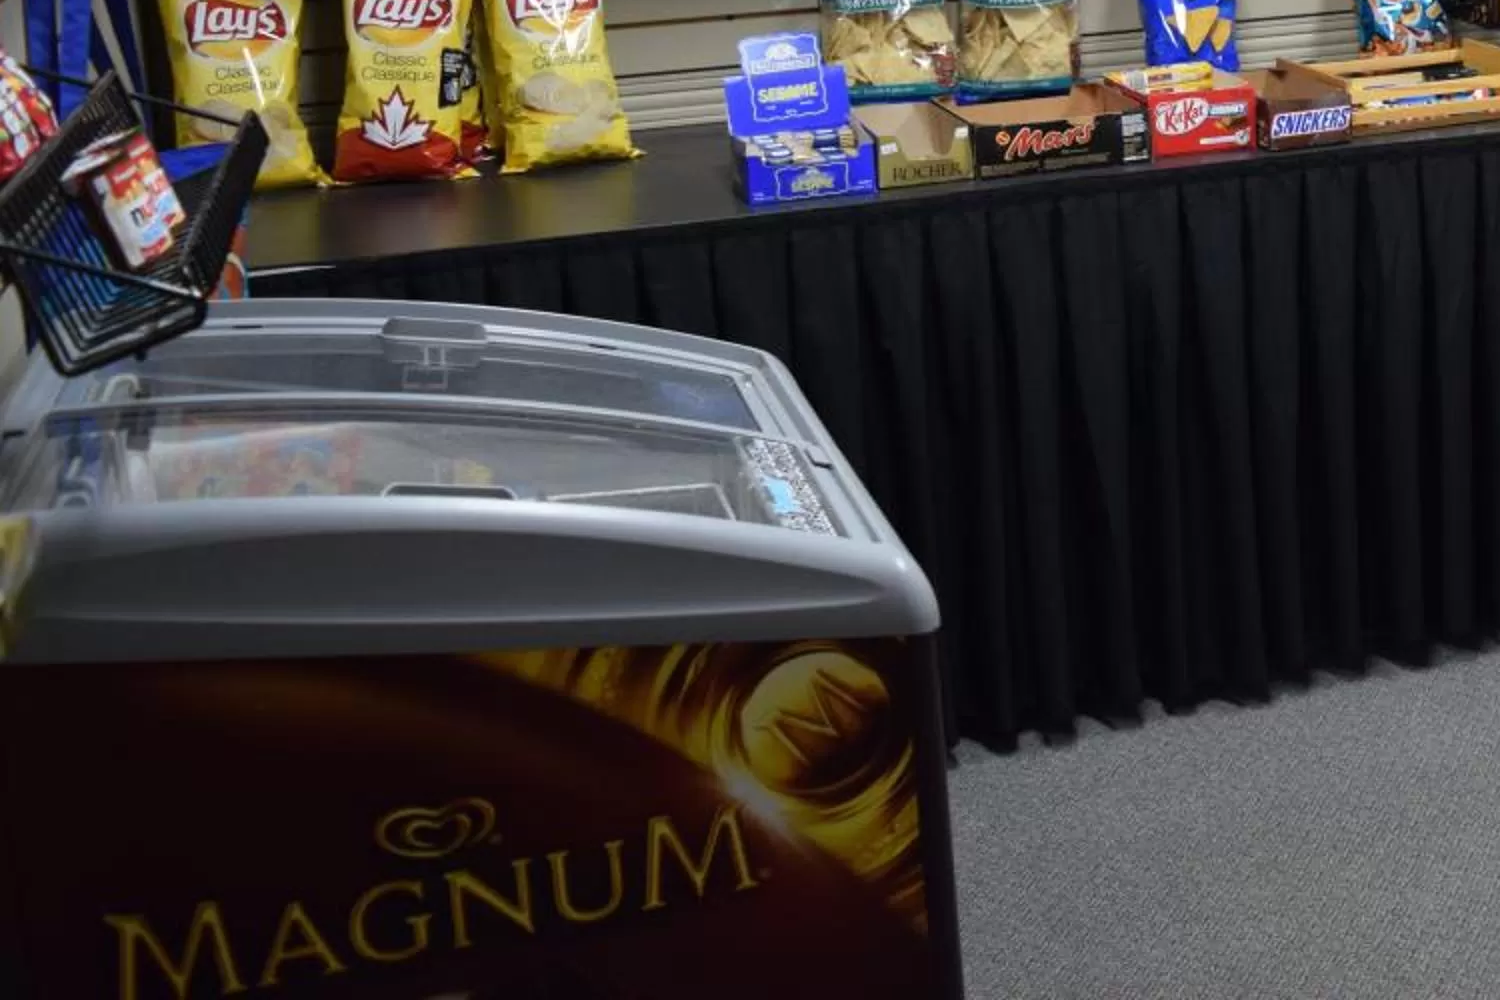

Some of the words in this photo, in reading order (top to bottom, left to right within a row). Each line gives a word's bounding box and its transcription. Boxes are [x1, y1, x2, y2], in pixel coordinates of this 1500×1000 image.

[191, 0, 277, 44] Lay's
[372, 51, 428, 66] Classic
[360, 67, 436, 83] Classique
[1272, 107, 1350, 137] SNICKERS
[1003, 122, 1095, 161] Mars
[890, 160, 963, 184] ROCHER
[103, 804, 761, 1000] MAGNUM
